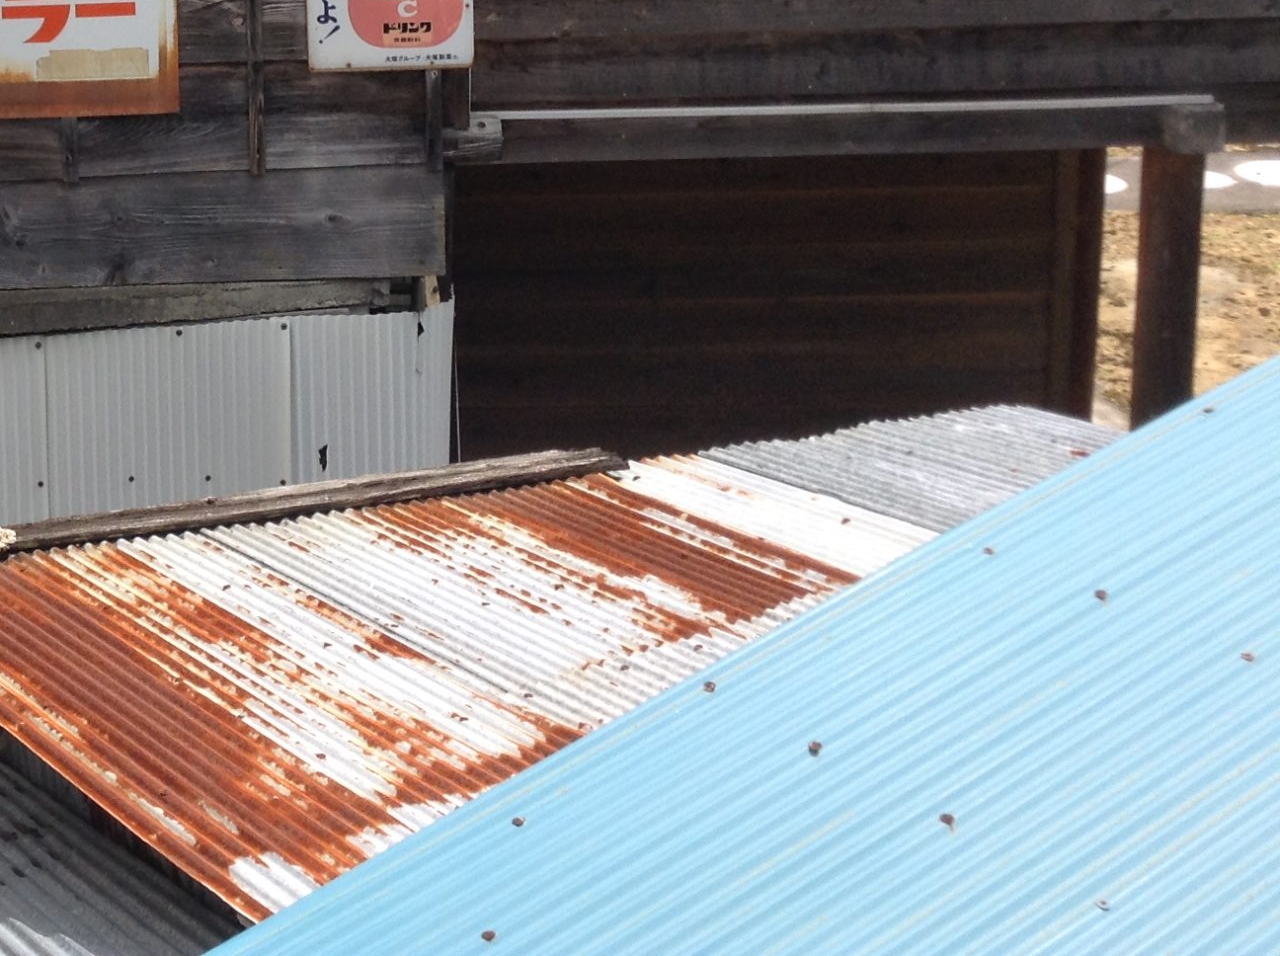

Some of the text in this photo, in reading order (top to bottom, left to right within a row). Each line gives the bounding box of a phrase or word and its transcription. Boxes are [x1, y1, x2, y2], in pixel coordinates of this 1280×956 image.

[397, 0, 418, 18] C
[382, 21, 433, 34] ドリンク
